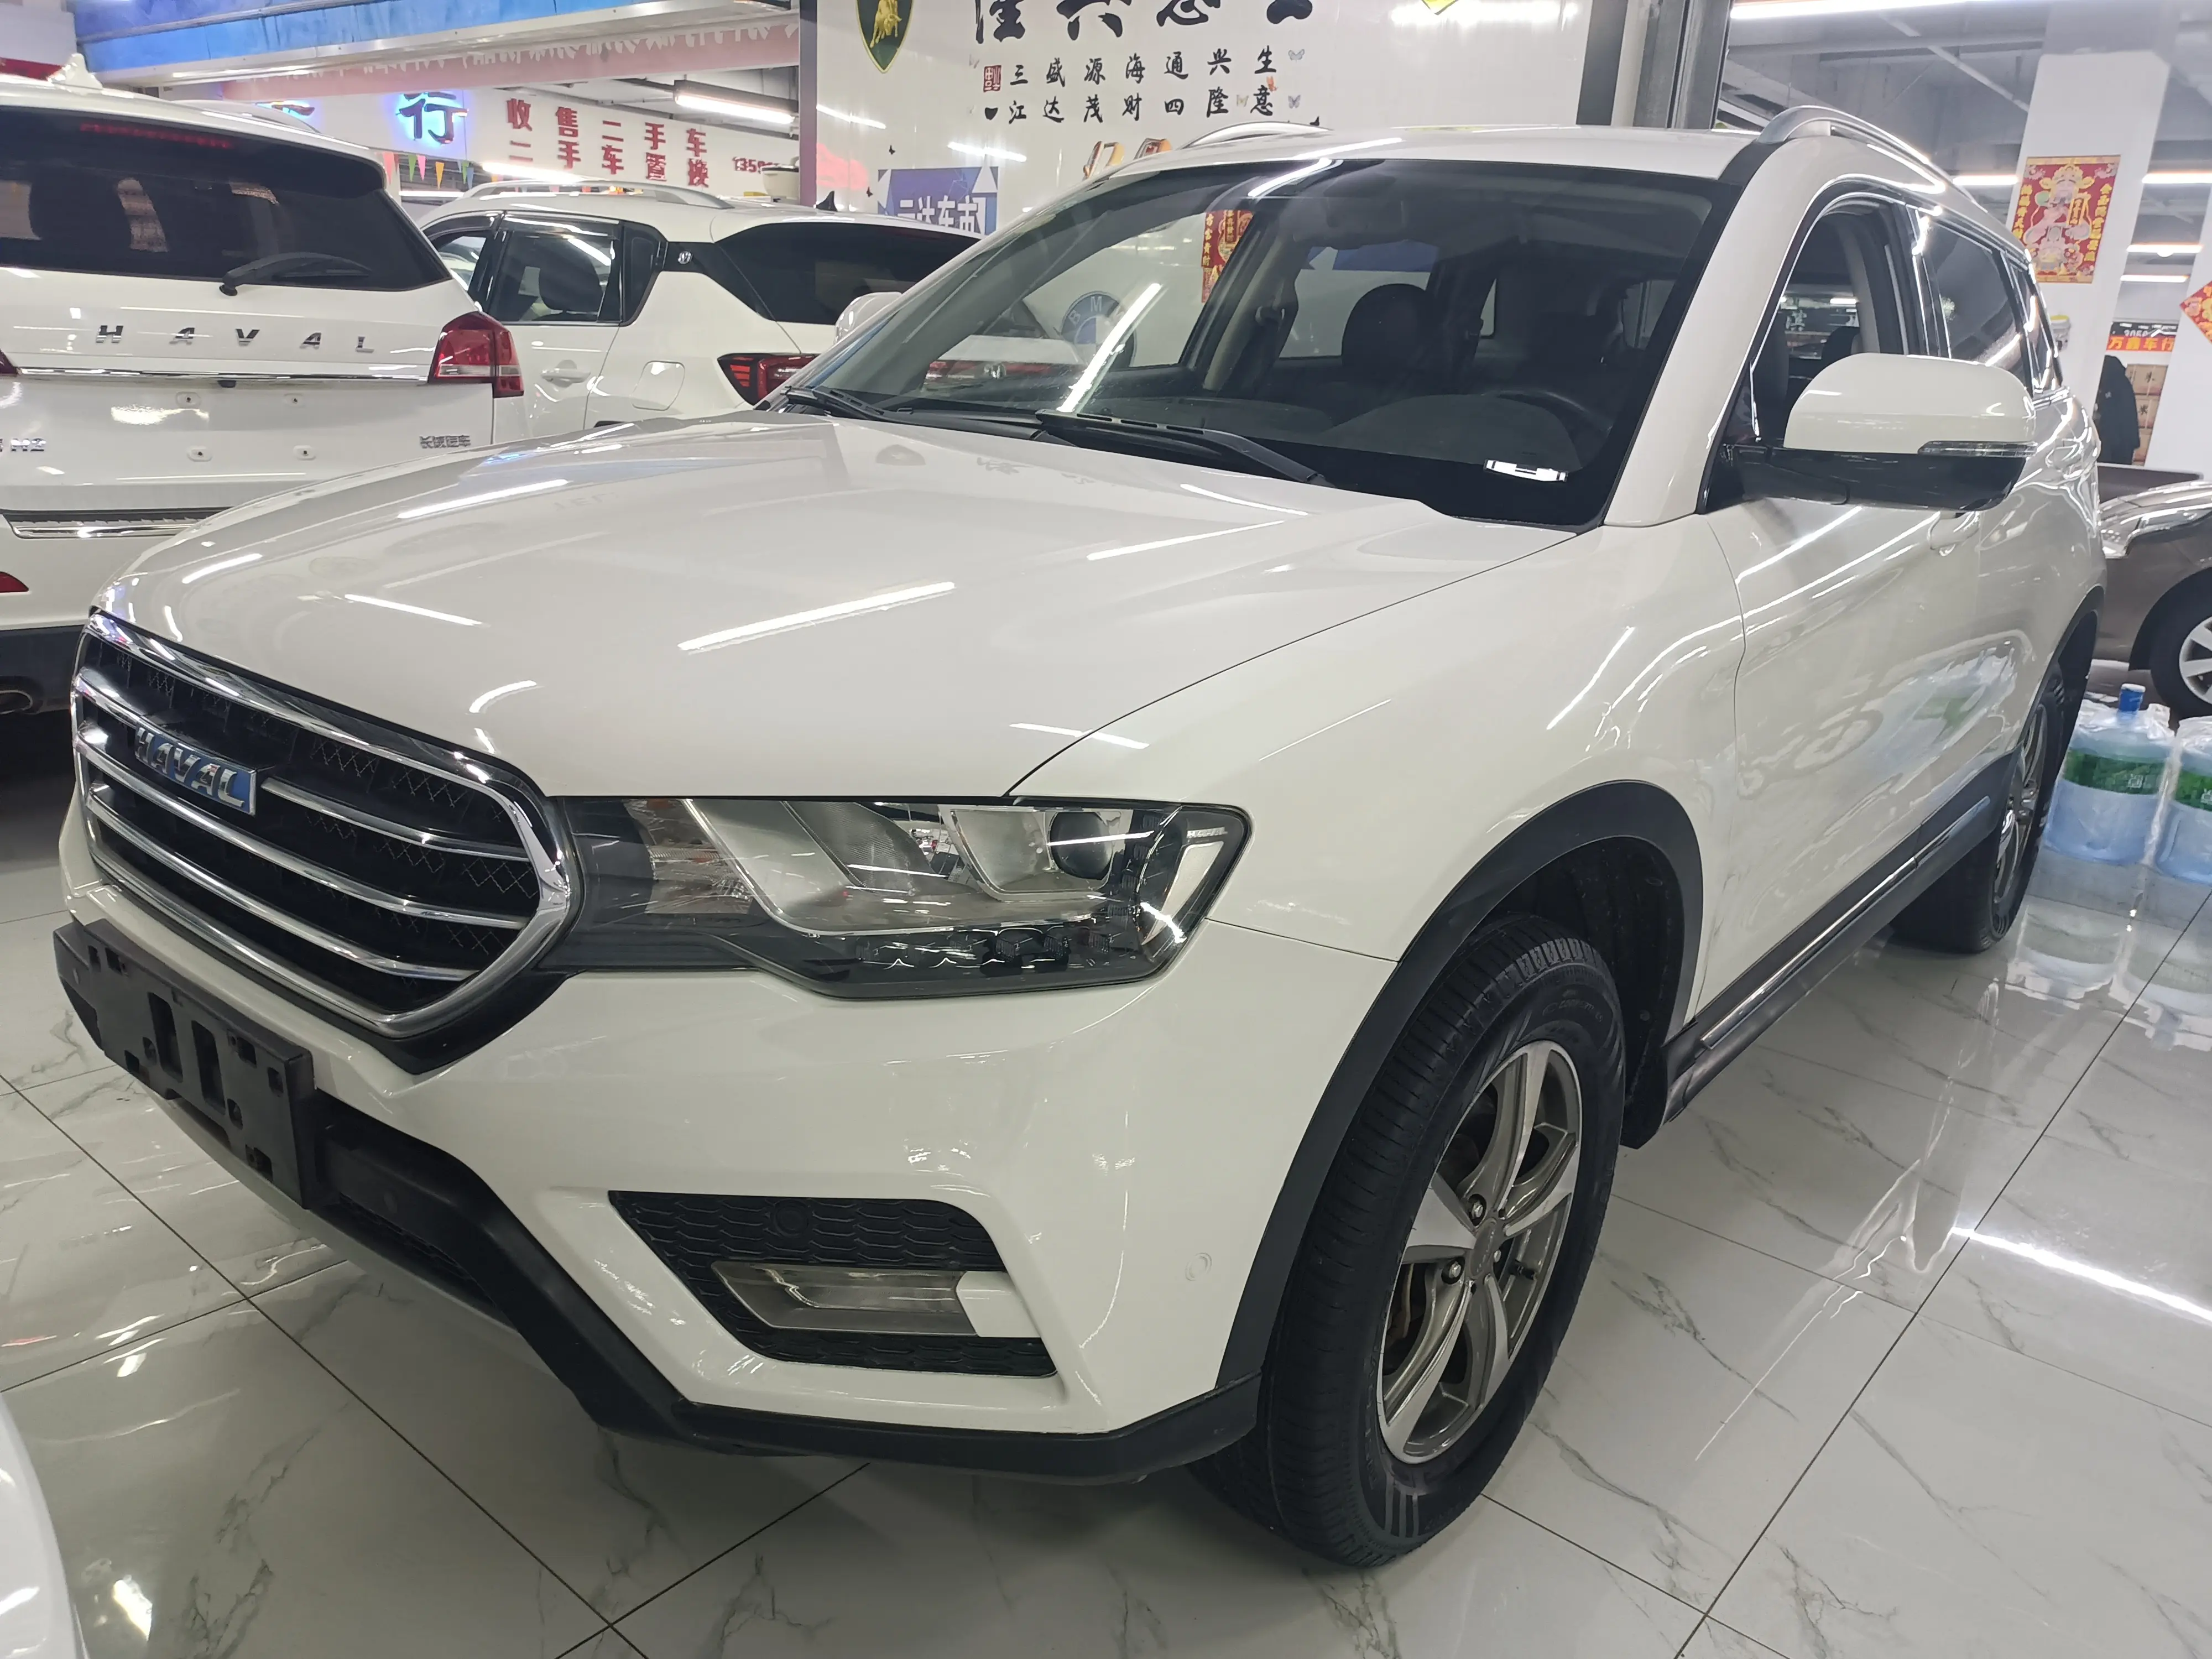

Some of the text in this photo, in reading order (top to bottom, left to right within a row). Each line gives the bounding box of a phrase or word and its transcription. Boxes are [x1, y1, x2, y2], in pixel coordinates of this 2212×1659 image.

[507, 98, 708, 156] 收售二手车
[96, 325, 374, 353] HAVAL
[134, 727, 245, 807] HAVAL
